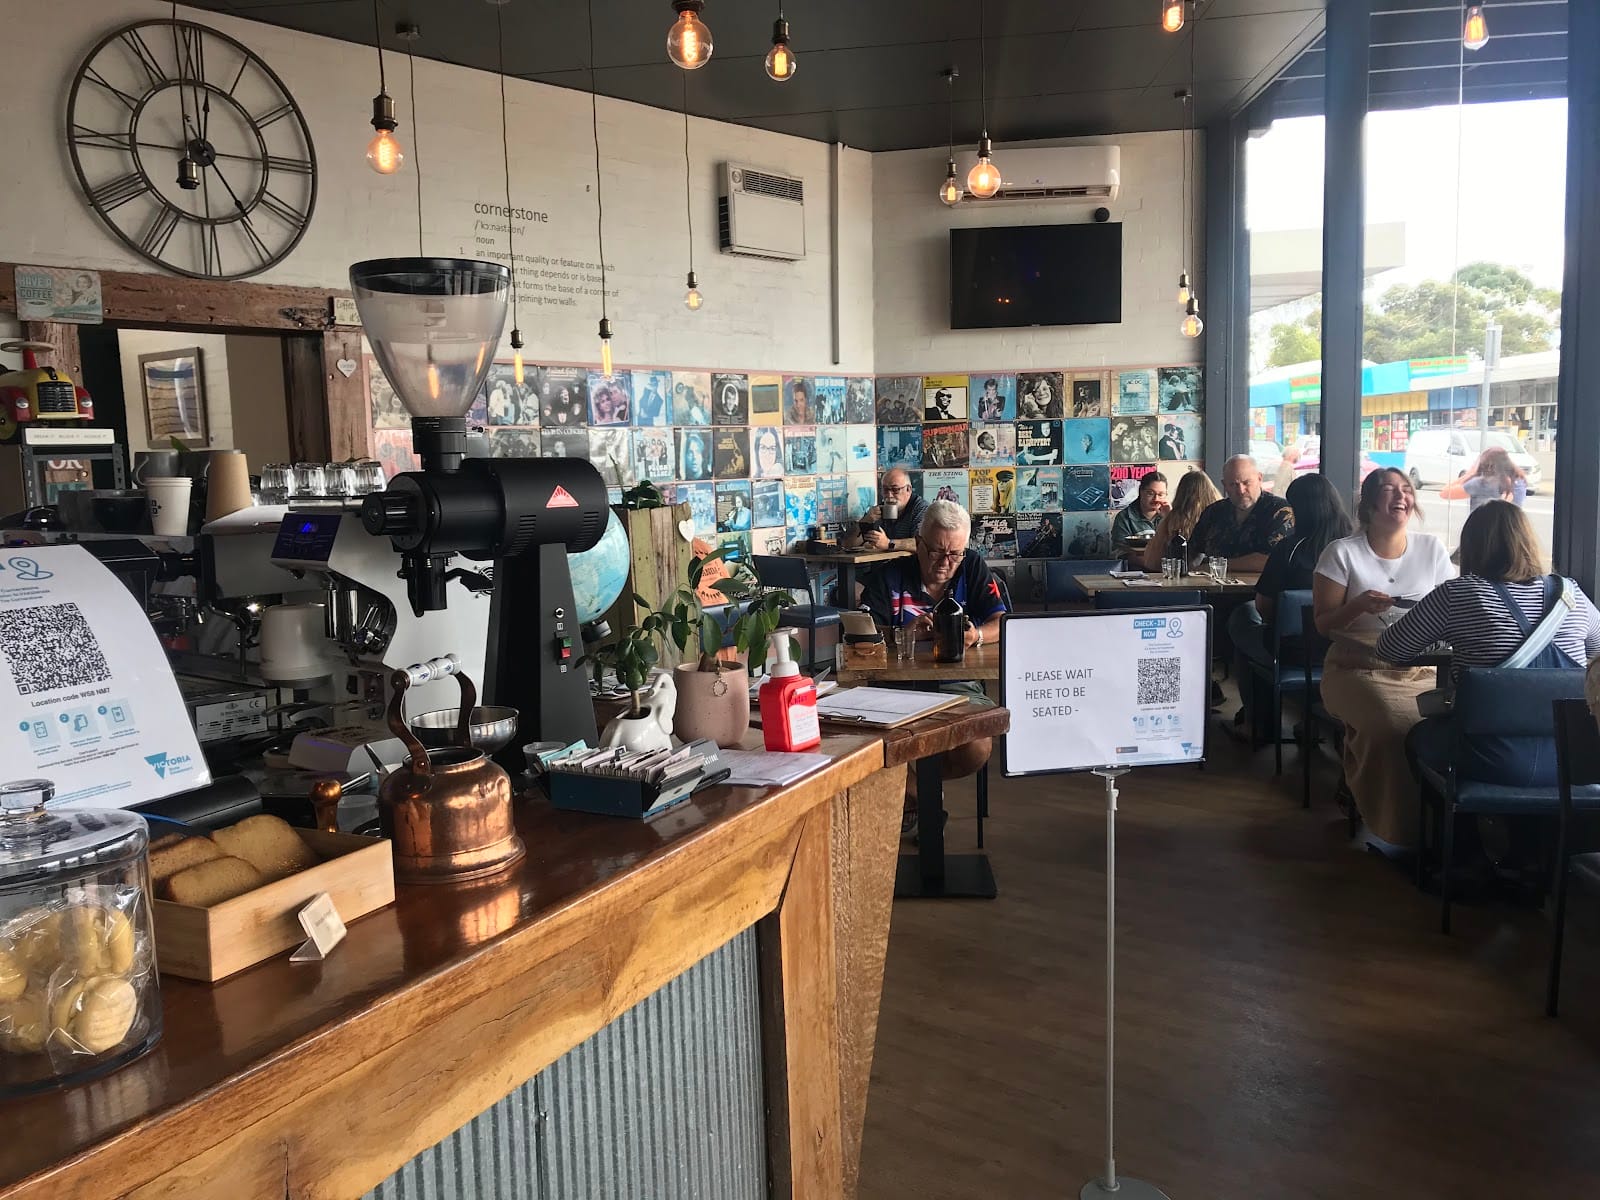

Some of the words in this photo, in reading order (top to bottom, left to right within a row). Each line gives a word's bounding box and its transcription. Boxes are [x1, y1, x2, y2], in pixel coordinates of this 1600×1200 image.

[474, 202, 549, 223] cornerstone
[475, 236, 495, 245] noun
[525, 255, 550, 266] quality
[560, 257, 585, 269] feature
[586, 262, 595, 270] on
[20, 273, 44, 288] HAVE
[520, 267, 539, 278] thing
[540, 269, 570, 281] depends
[580, 273, 585, 281] is
[20, 288, 53, 299] COFFEE
[523, 281, 543, 291] forms
[545, 283, 557, 292] the
[558, 284, 575, 294] base
[576, 286, 584, 294] of
[518, 294, 543, 306] joining
[544, 296, 557, 305] two
[923, 422, 968, 438] SUPERNAUT
[1111, 466, 1129, 479] 200
[1134, 618, 1166, 628] CHECK-IN
[1143, 630, 1156, 638] NOW
[1025, 670, 1062, 682] PLEASE
[1065, 668, 1094, 680] WAIT
[31, 696, 61, 707] Location
[62, 693, 80, 702] code
[1025, 688, 1053, 700] HERE
[1056, 687, 1070, 698] TO
[1073, 686, 1086, 697] BE
[1032, 705, 1072, 718] SEATED
[153, 754, 192, 769] VICTORIA
